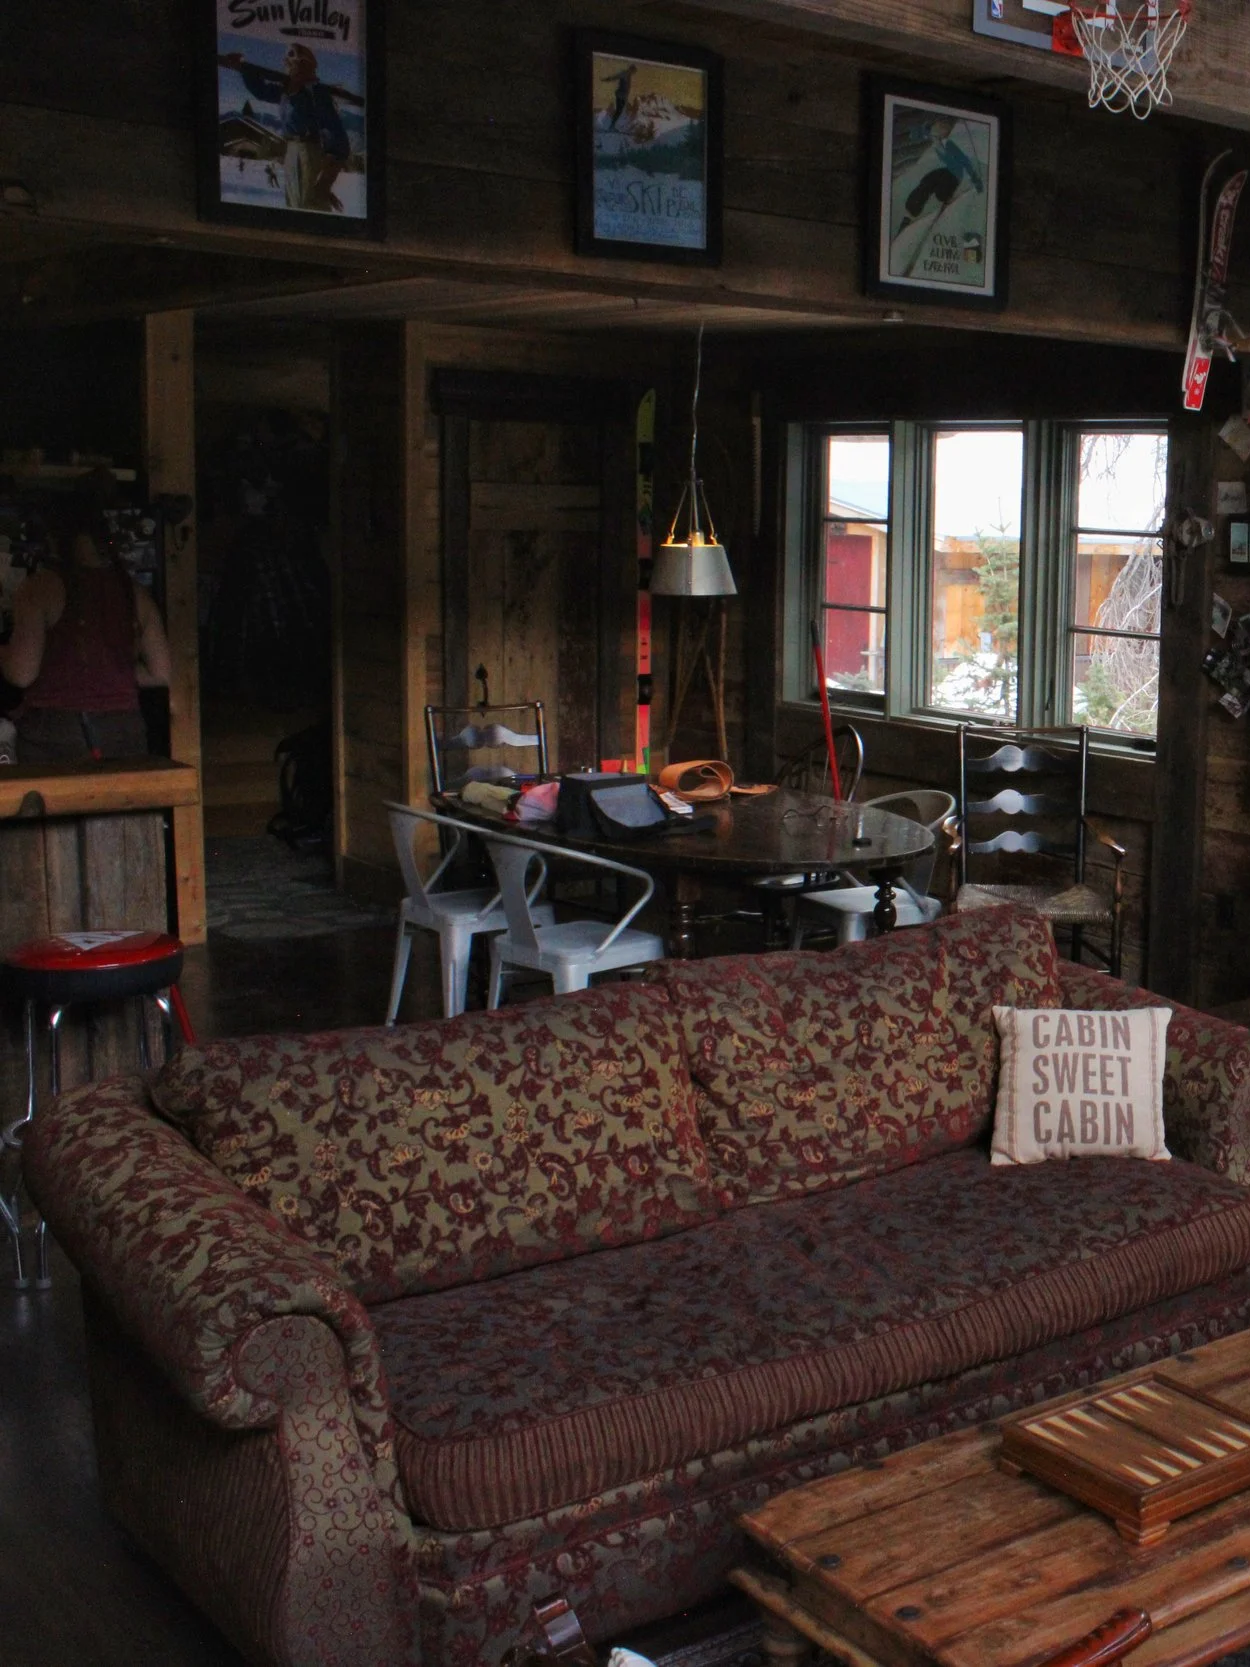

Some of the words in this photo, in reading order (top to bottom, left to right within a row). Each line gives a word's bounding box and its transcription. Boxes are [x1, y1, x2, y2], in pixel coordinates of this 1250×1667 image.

[228, 0, 284, 28] Sun
[288, 0, 350, 41] Valley
[621, 181, 664, 216] SKI
[1032, 1014, 1131, 1050] CABIN
[1032, 1052, 1132, 1097] SWEET
[1032, 1099, 1135, 1146] CABIN
